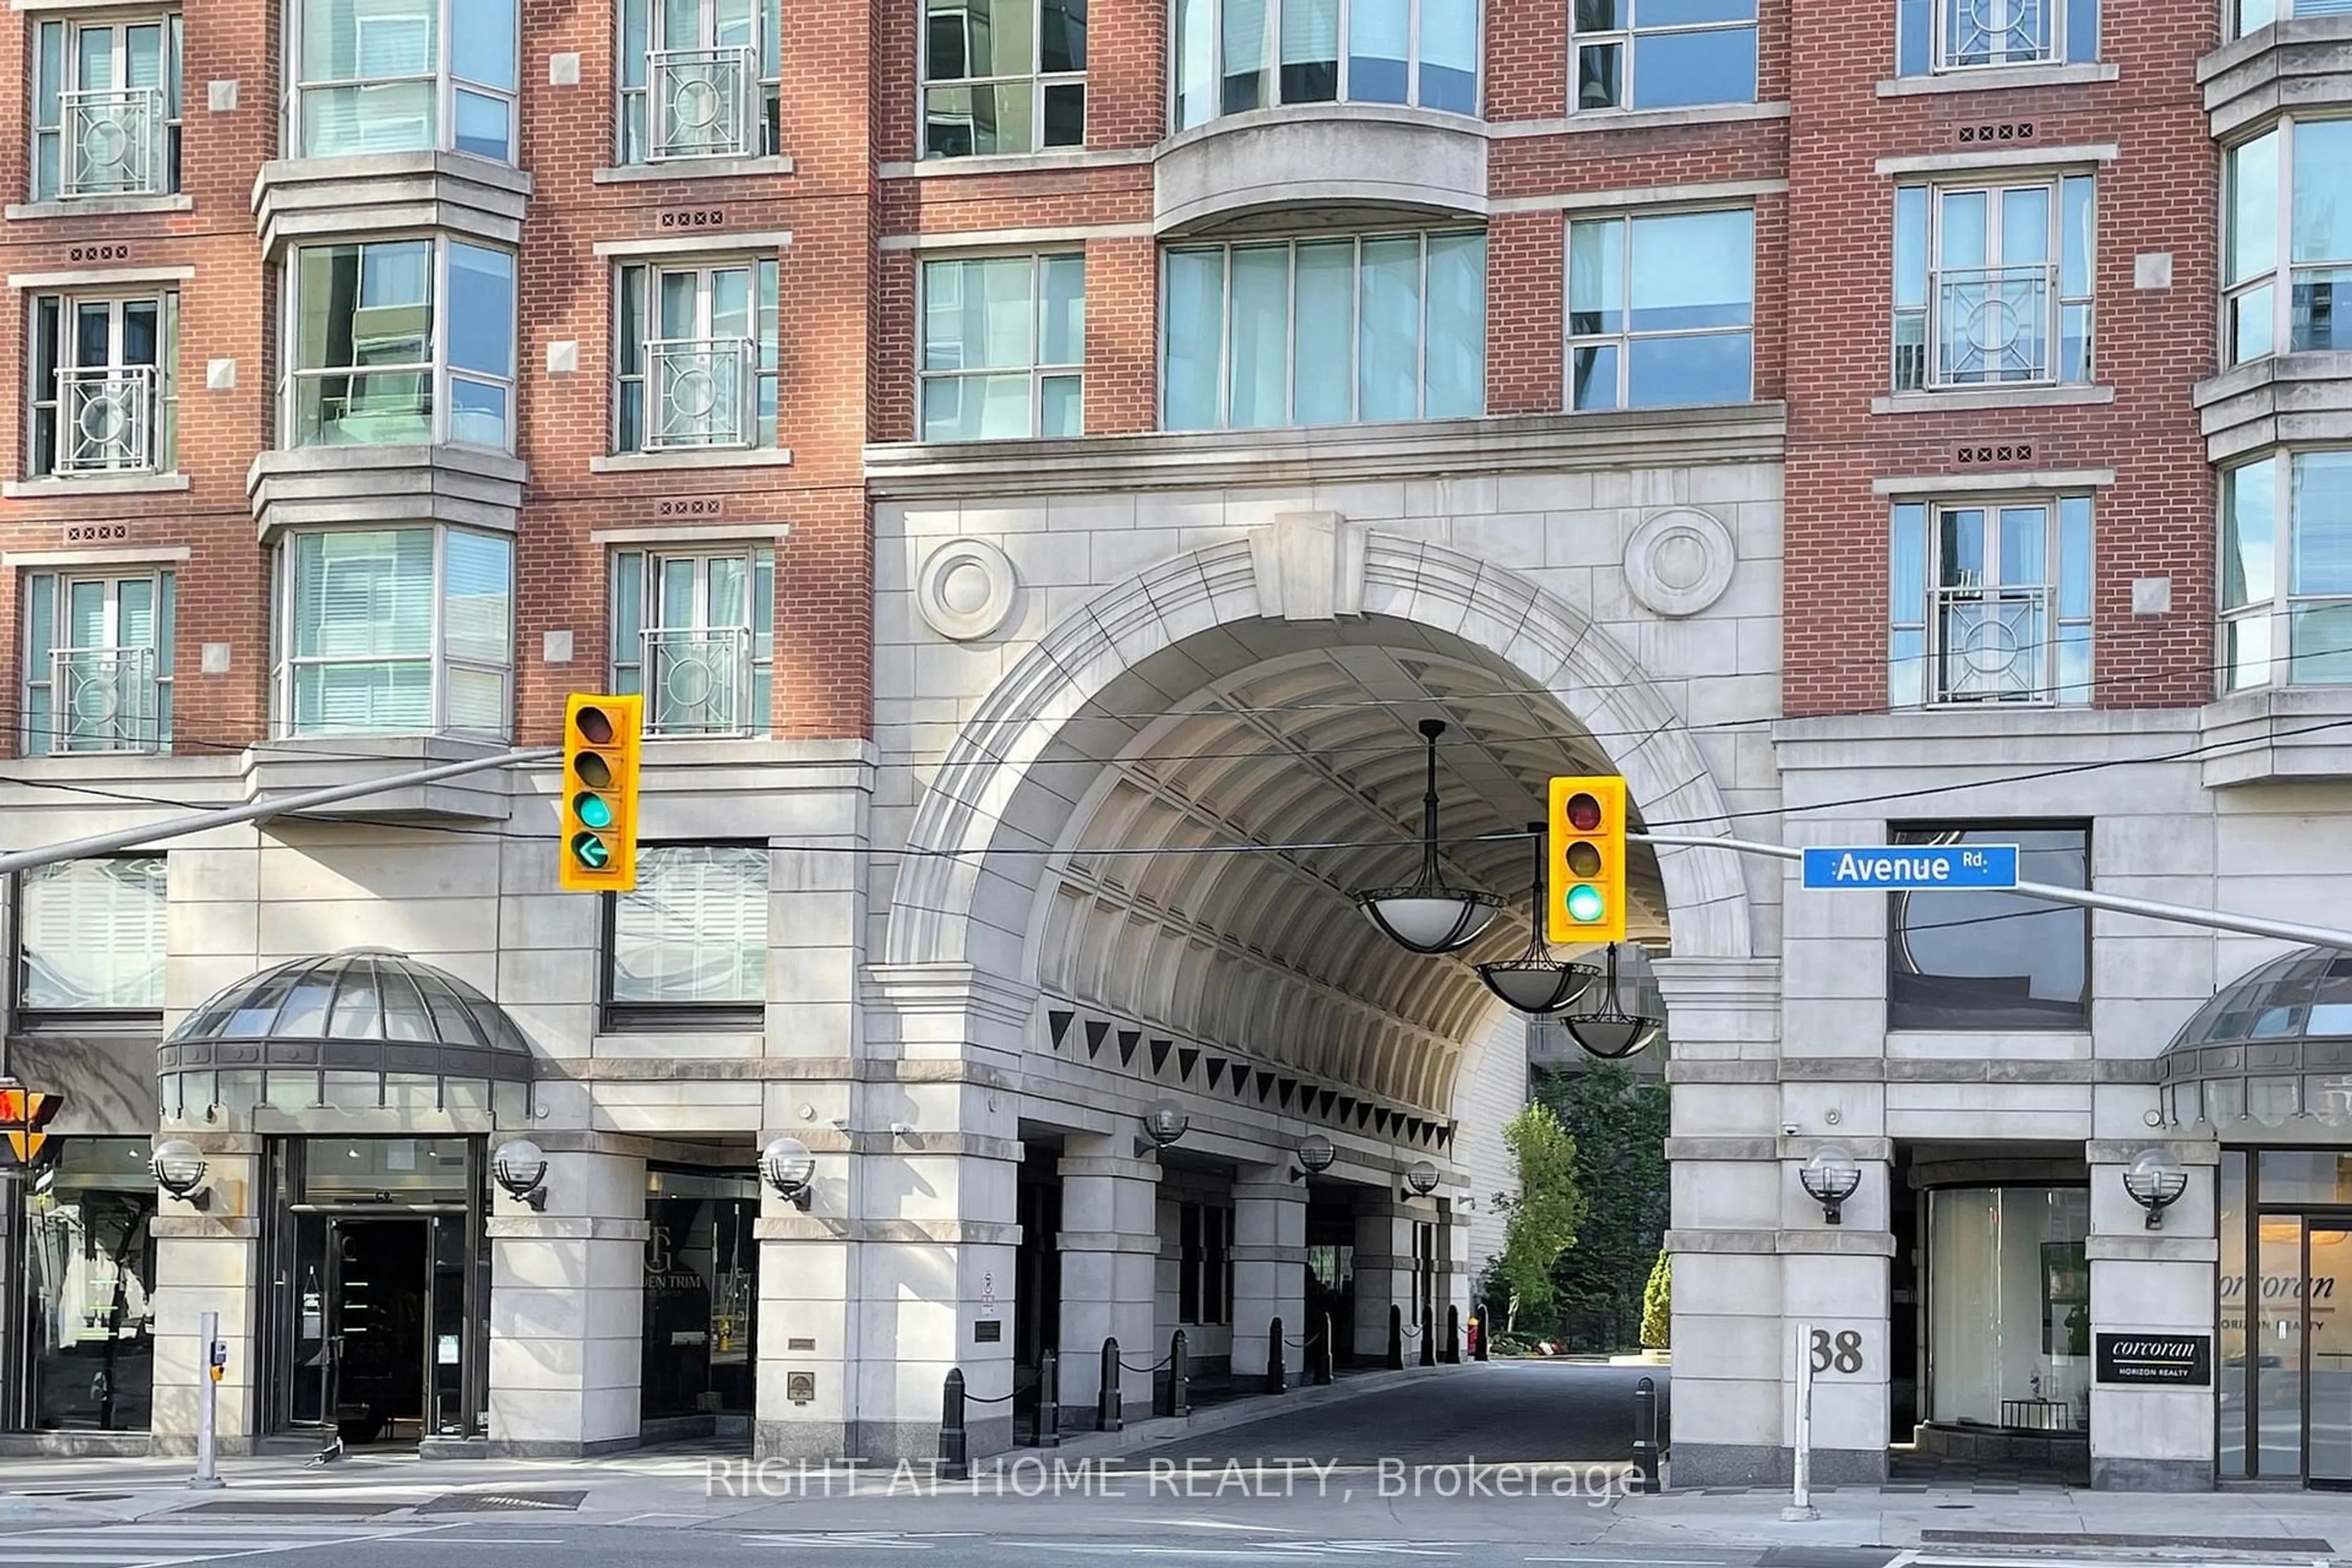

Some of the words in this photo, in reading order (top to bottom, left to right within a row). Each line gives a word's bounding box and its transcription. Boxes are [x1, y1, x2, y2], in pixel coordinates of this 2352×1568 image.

[1837, 853, 1950, 881] Avenue
[669, 1275, 701, 1288] TRIM
[1811, 1329, 1863, 1374] 38
[2113, 1341, 2195, 1357] corcoran
